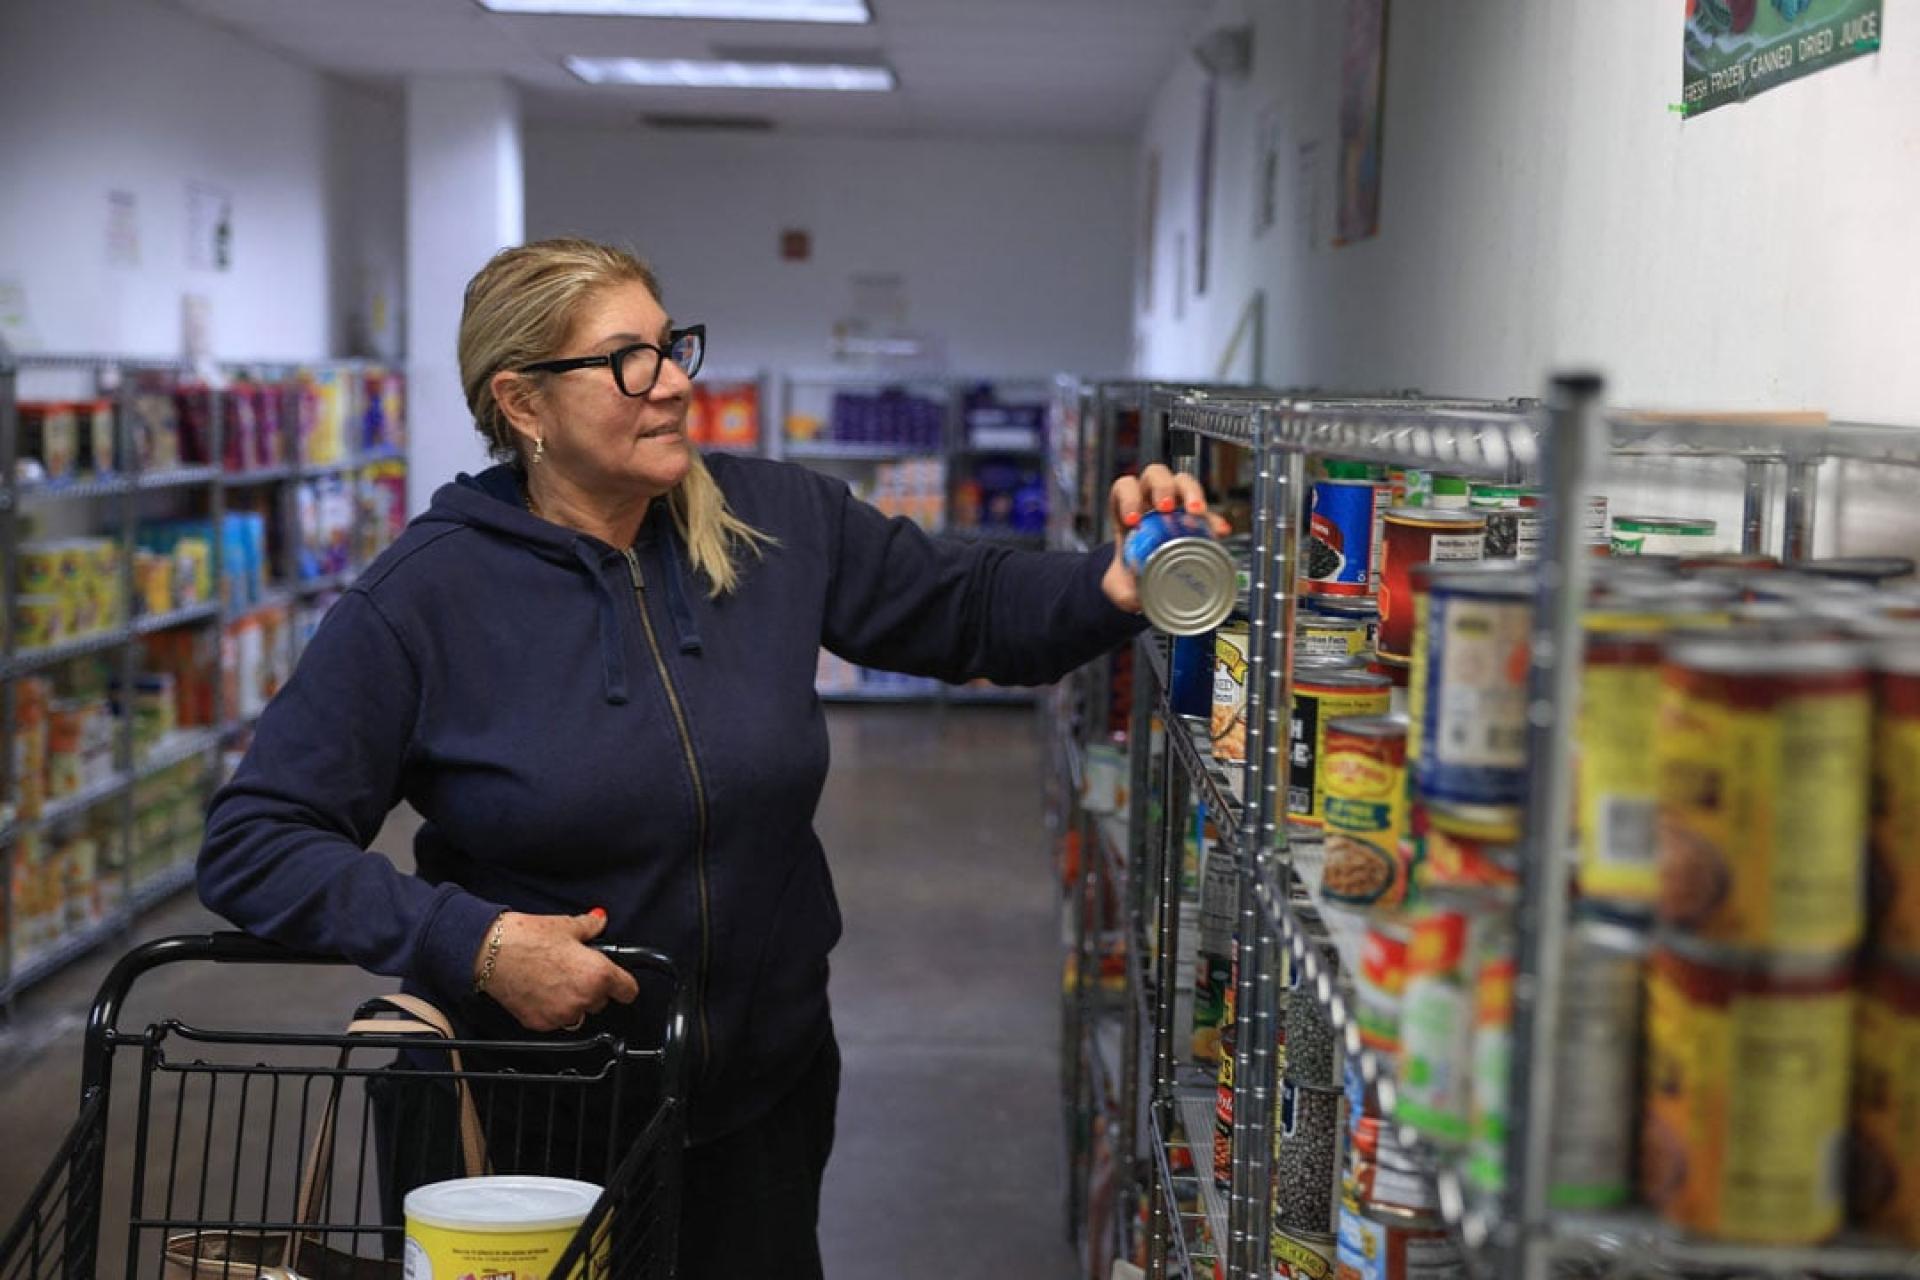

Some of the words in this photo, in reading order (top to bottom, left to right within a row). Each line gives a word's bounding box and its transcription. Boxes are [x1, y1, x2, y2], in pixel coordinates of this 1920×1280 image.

[1711, 64, 1746, 95] FROZEN
[1751, 44, 1792, 78] CANNED
[1799, 28, 1833, 62] DRIED
[1840, 11, 1877, 47] JUICE
